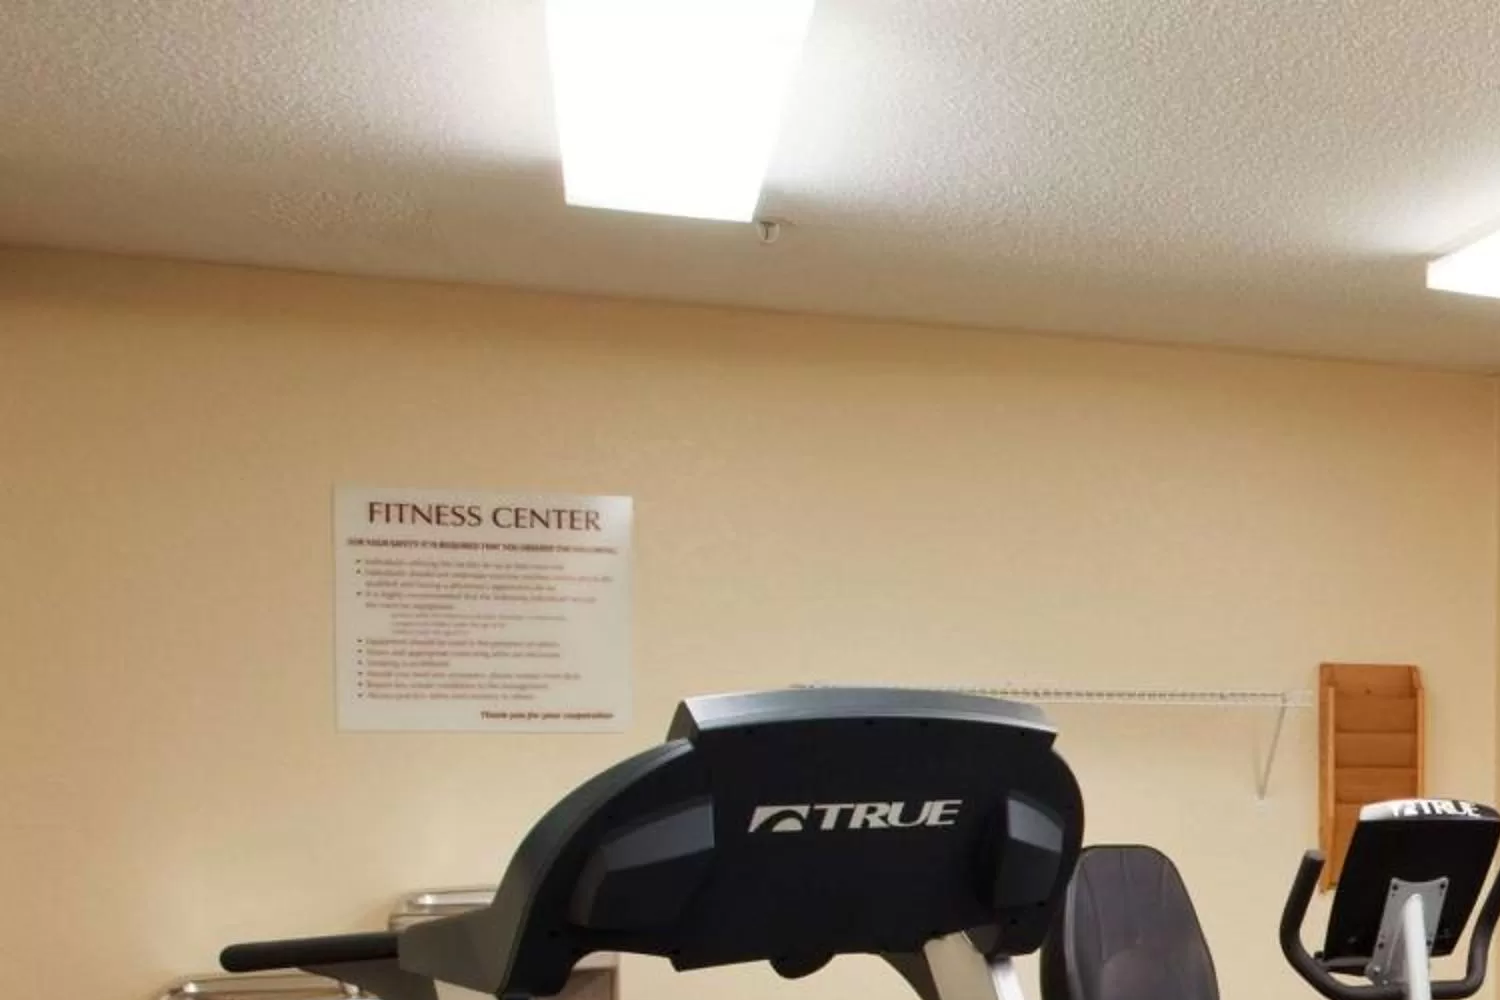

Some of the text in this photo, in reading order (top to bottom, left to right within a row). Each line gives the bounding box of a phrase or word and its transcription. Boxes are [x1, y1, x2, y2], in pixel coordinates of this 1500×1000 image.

[368, 501, 602, 531] FITNESS CENTER
[813, 799, 963, 830] TRUE
[1418, 799, 1481, 819] TRUE
